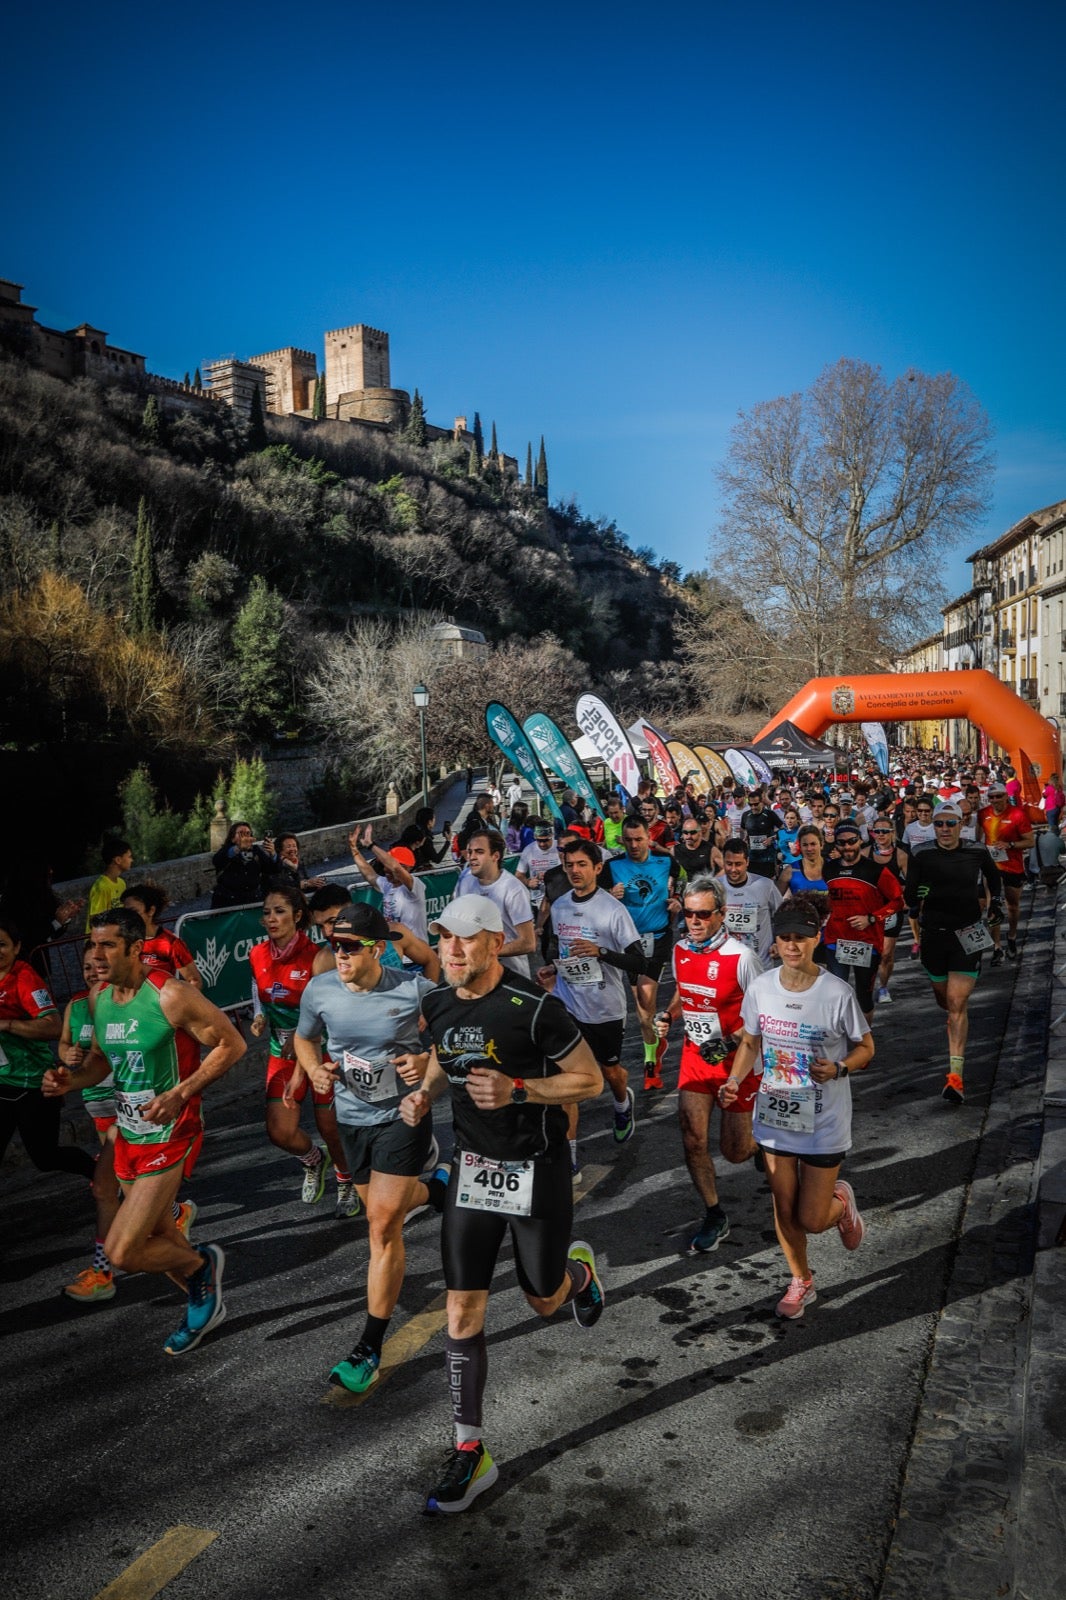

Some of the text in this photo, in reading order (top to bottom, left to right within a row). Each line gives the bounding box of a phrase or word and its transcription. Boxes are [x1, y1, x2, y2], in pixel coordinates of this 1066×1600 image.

[859, 692, 914, 701] AYUNTAMIENTO
[920, 698, 954, 706] Deportes
[728, 913, 750, 923] 325
[968, 930, 986, 942] 134
[843, 946, 865, 956] 524
[565, 963, 590, 973] 218
[686, 1020, 712, 1035] 393
[758, 1013, 798, 1031] 9 Carrera
[765, 1025, 799, 1038] Solidaria
[455, 1042, 485, 1051] RUNNING
[352, 1068, 385, 1085] 607
[768, 1096, 801, 1114] 292
[465, 1154, 474, 1166] 9
[473, 1169, 520, 1192] 406
